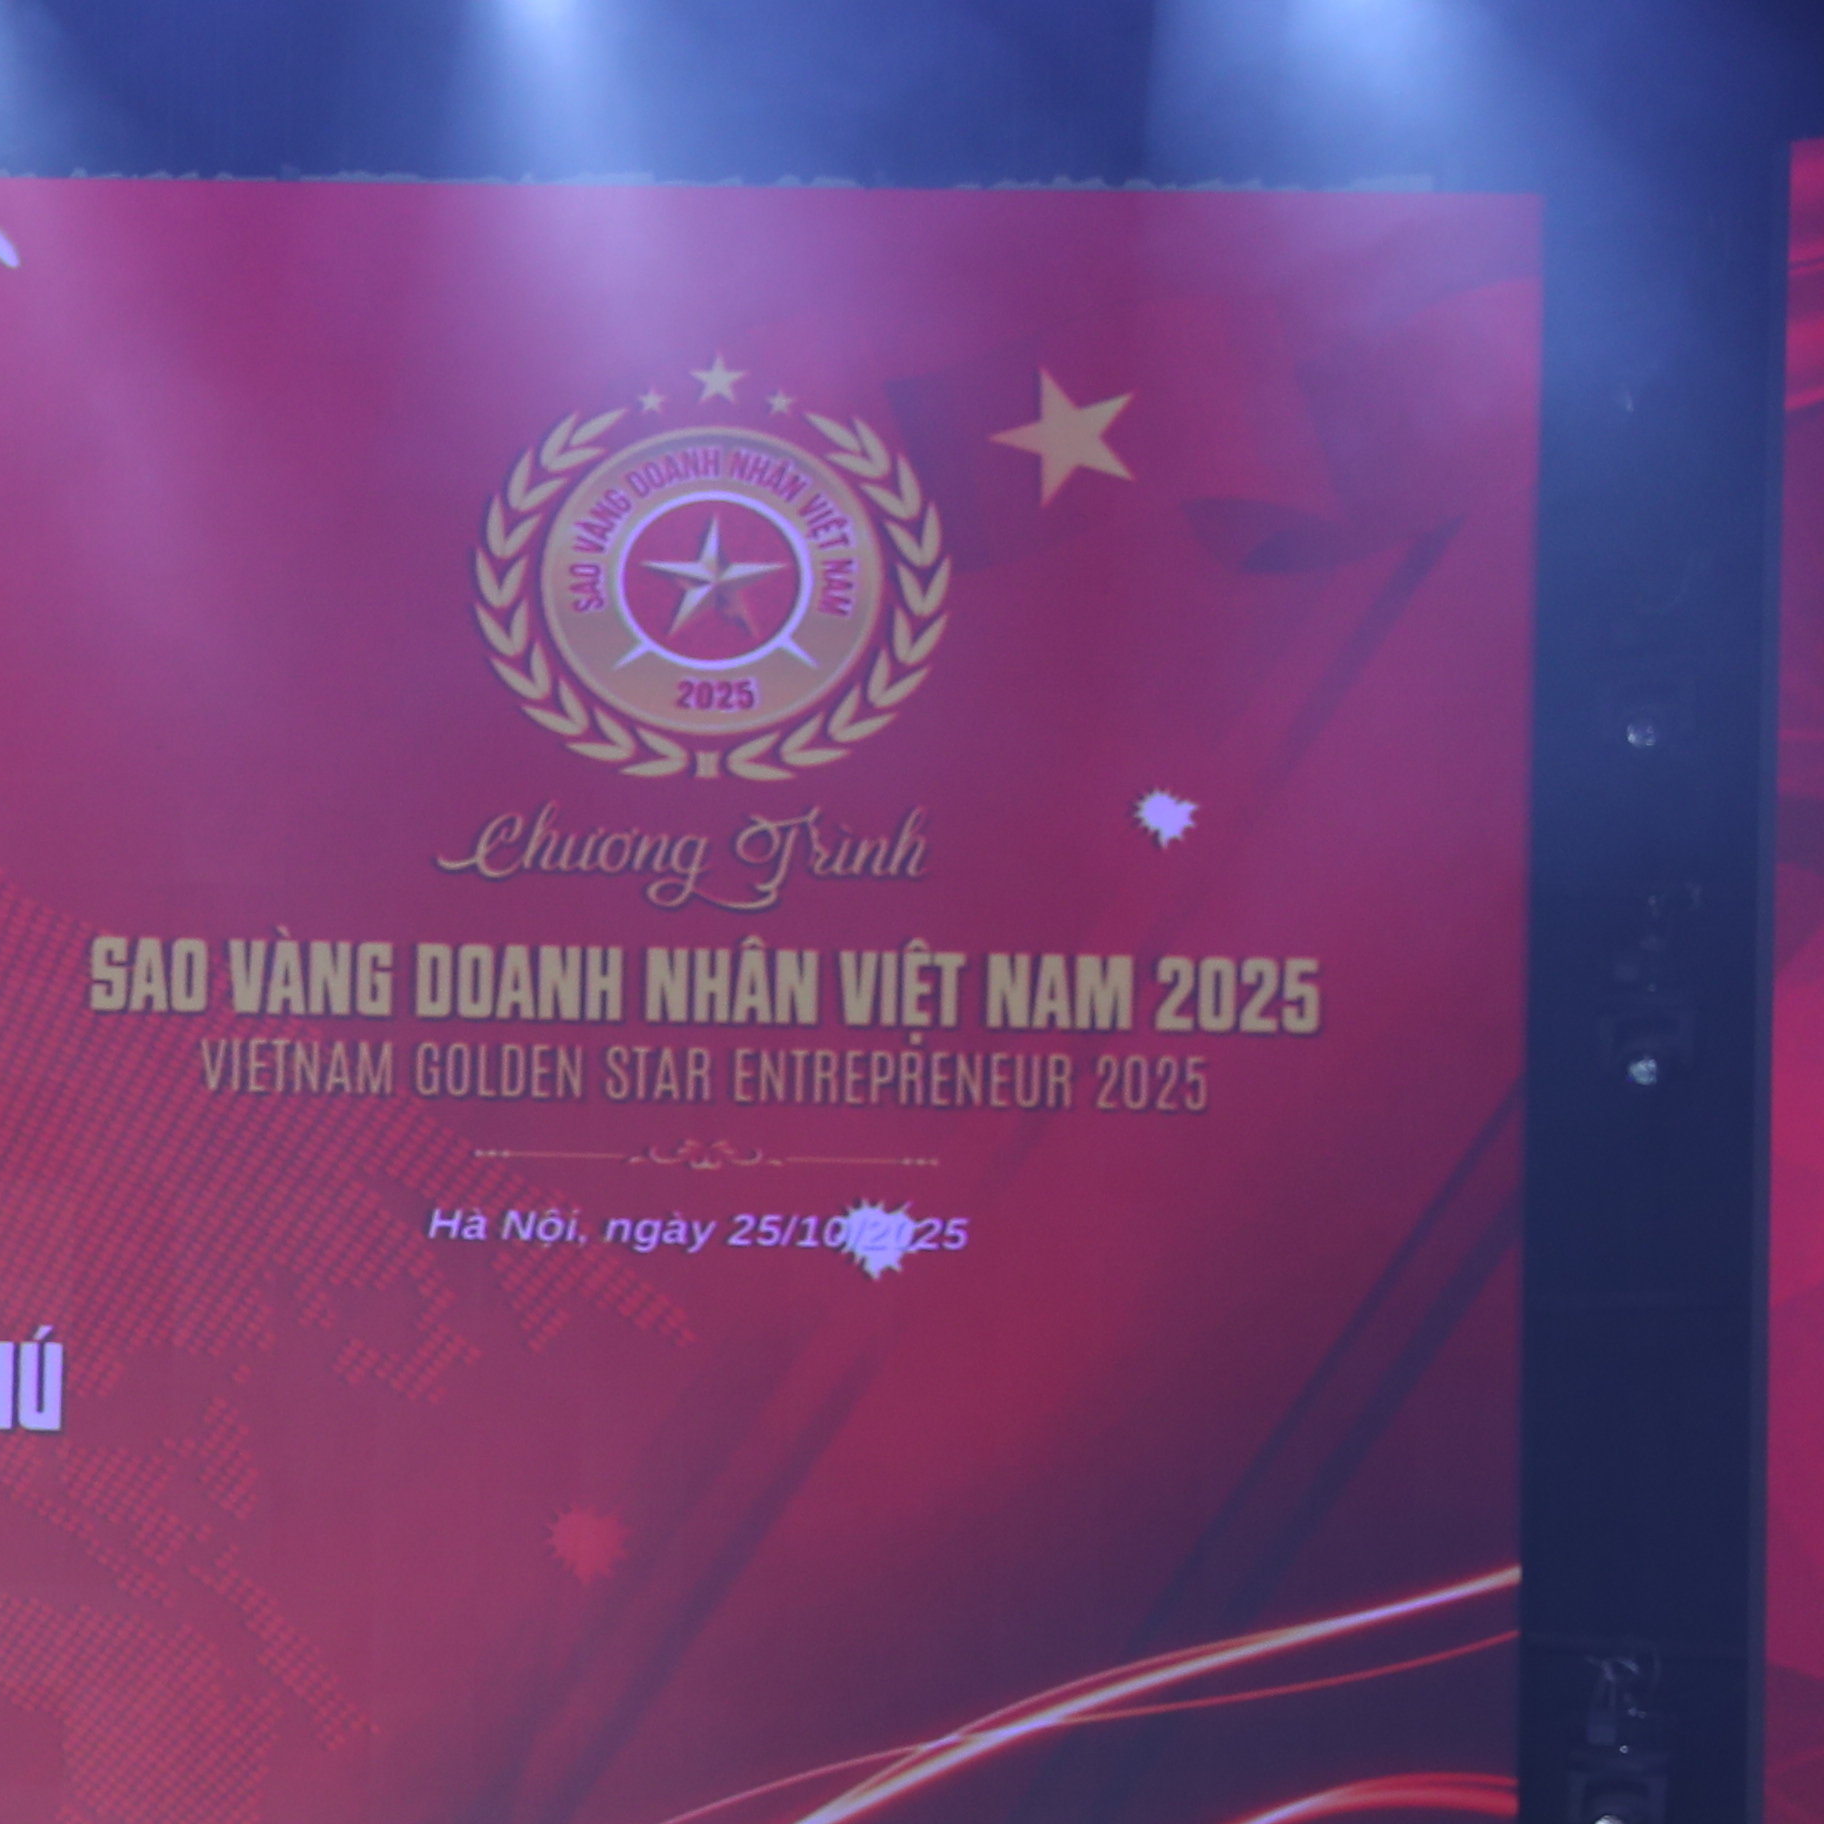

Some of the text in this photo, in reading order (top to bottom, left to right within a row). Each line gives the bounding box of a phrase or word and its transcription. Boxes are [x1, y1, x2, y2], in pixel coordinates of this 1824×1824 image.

[569, 563, 606, 614] SAO
[625, 447, 723, 498] DOANH
[817, 558, 857, 617] NAM
[675, 676, 759, 712] 2025
[437, 800, 929, 909] Chương Trình
[90, 926, 1320, 1046] SAO VÀNG DOANH NHÂN VIỆT NAM 2025
[201, 1038, 1208, 1112] VIETNAM GOLDEN STAR ENTREPRENEUR 2025
[428, 1208, 487, 1241] Hà
[502, 1208, 587, 1248] Nội,
[604, 1211, 716, 1253] ngày
